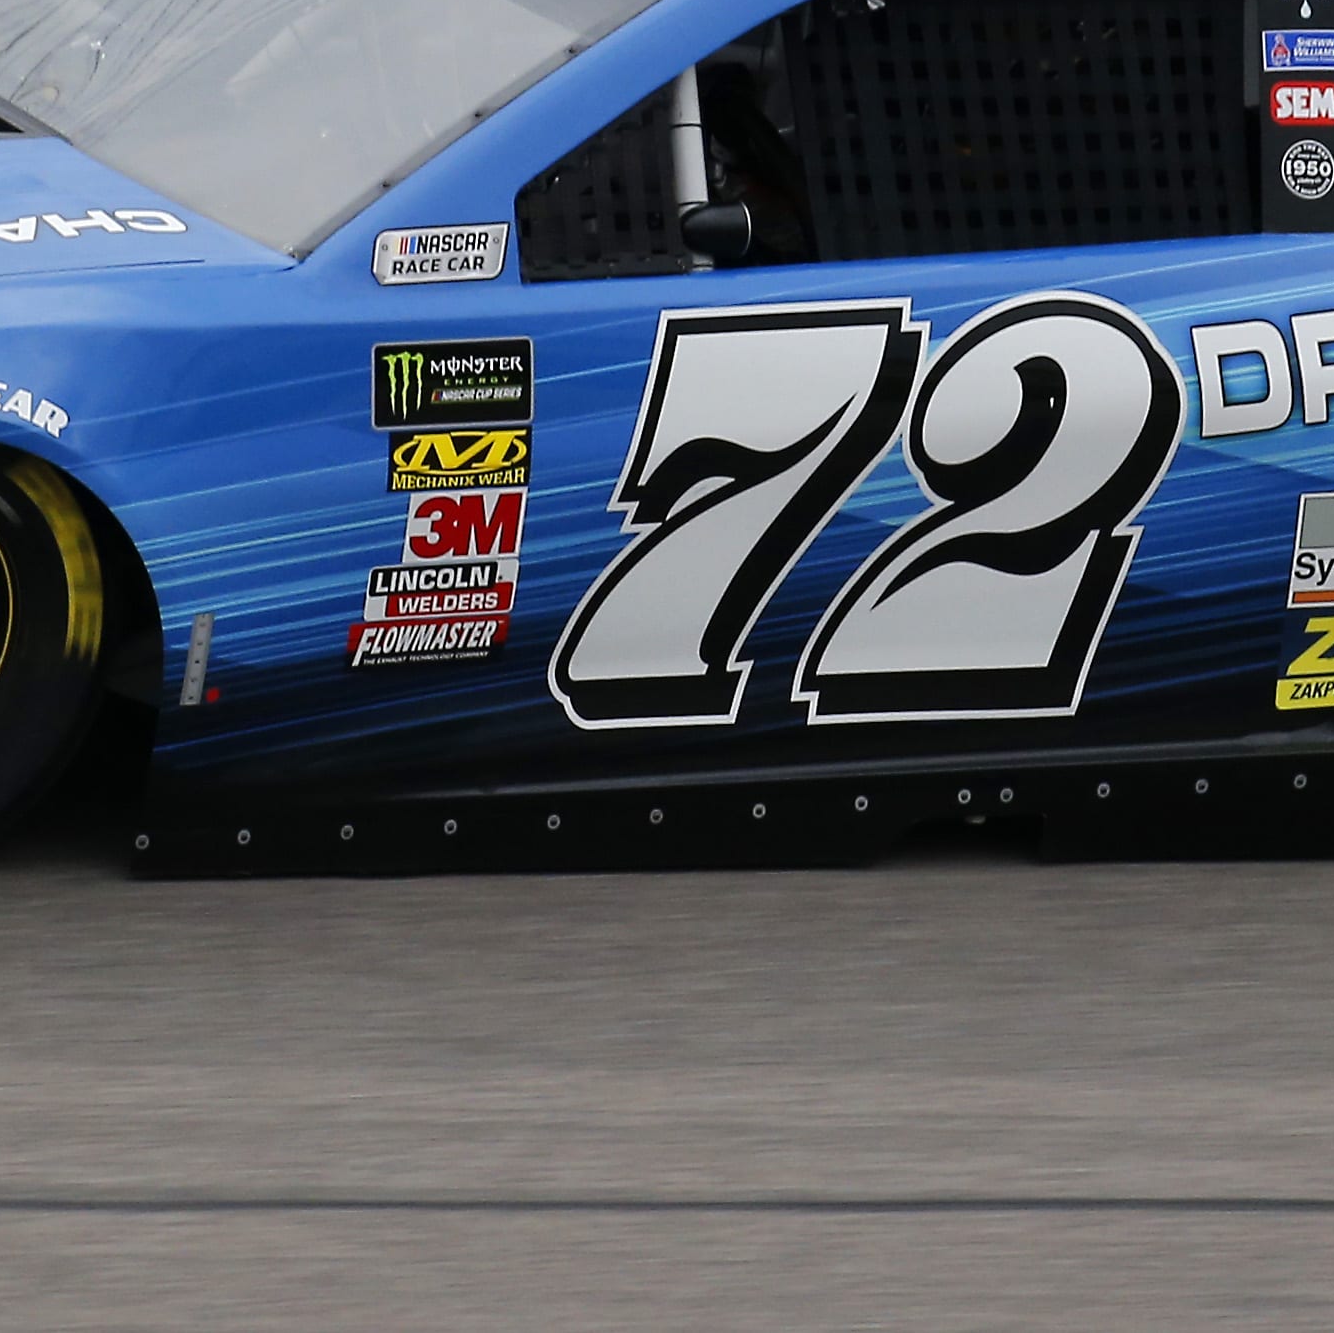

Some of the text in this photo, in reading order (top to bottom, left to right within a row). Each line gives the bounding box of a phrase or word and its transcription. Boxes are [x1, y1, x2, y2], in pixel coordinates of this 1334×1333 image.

[1286, 159, 1332, 177] 1950
[416, 232, 489, 254] NASCAR
[392, 256, 485, 275] RACE CAR
[430, 355, 524, 377] MONSTER
[444, 376, 508, 386] ENERGY
[476, 388, 494, 400] CUP
[392, 467, 525, 490] MECHANIX WEAR
[547, 289, 1189, 730] 72
[409, 492, 523, 559] 3M
[375, 565, 491, 594] LINCOLN
[397, 589, 499, 615] WELDERS
[351, 619, 499, 667] FLOWMASTER
